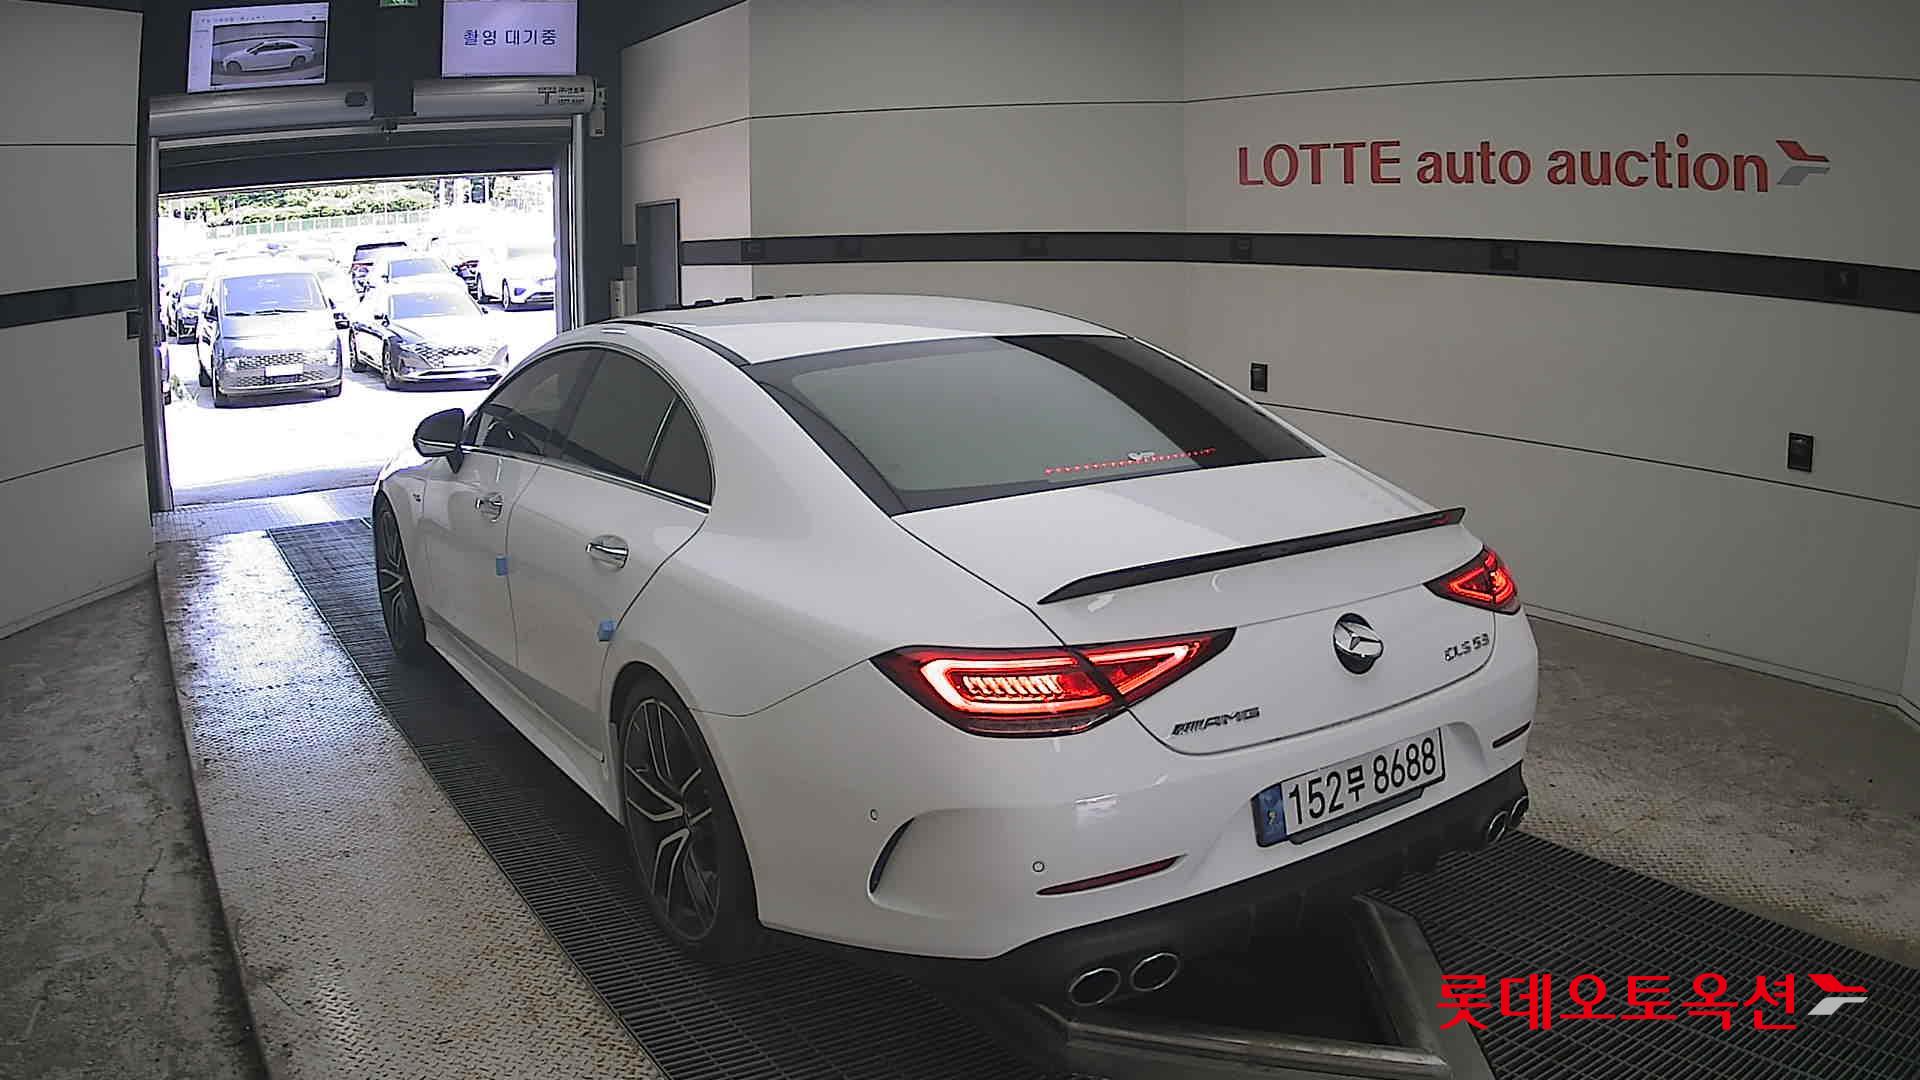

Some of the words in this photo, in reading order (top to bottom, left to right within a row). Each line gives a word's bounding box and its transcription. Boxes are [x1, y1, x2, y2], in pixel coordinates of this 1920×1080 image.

[505, 28, 557, 46] 대기중
[1238, 140, 1402, 187] LOTTE
[1416, 141, 1532, 186] auto
[1547, 133, 1769, 193] auction
[1373, 737, 1436, 794] 8688
